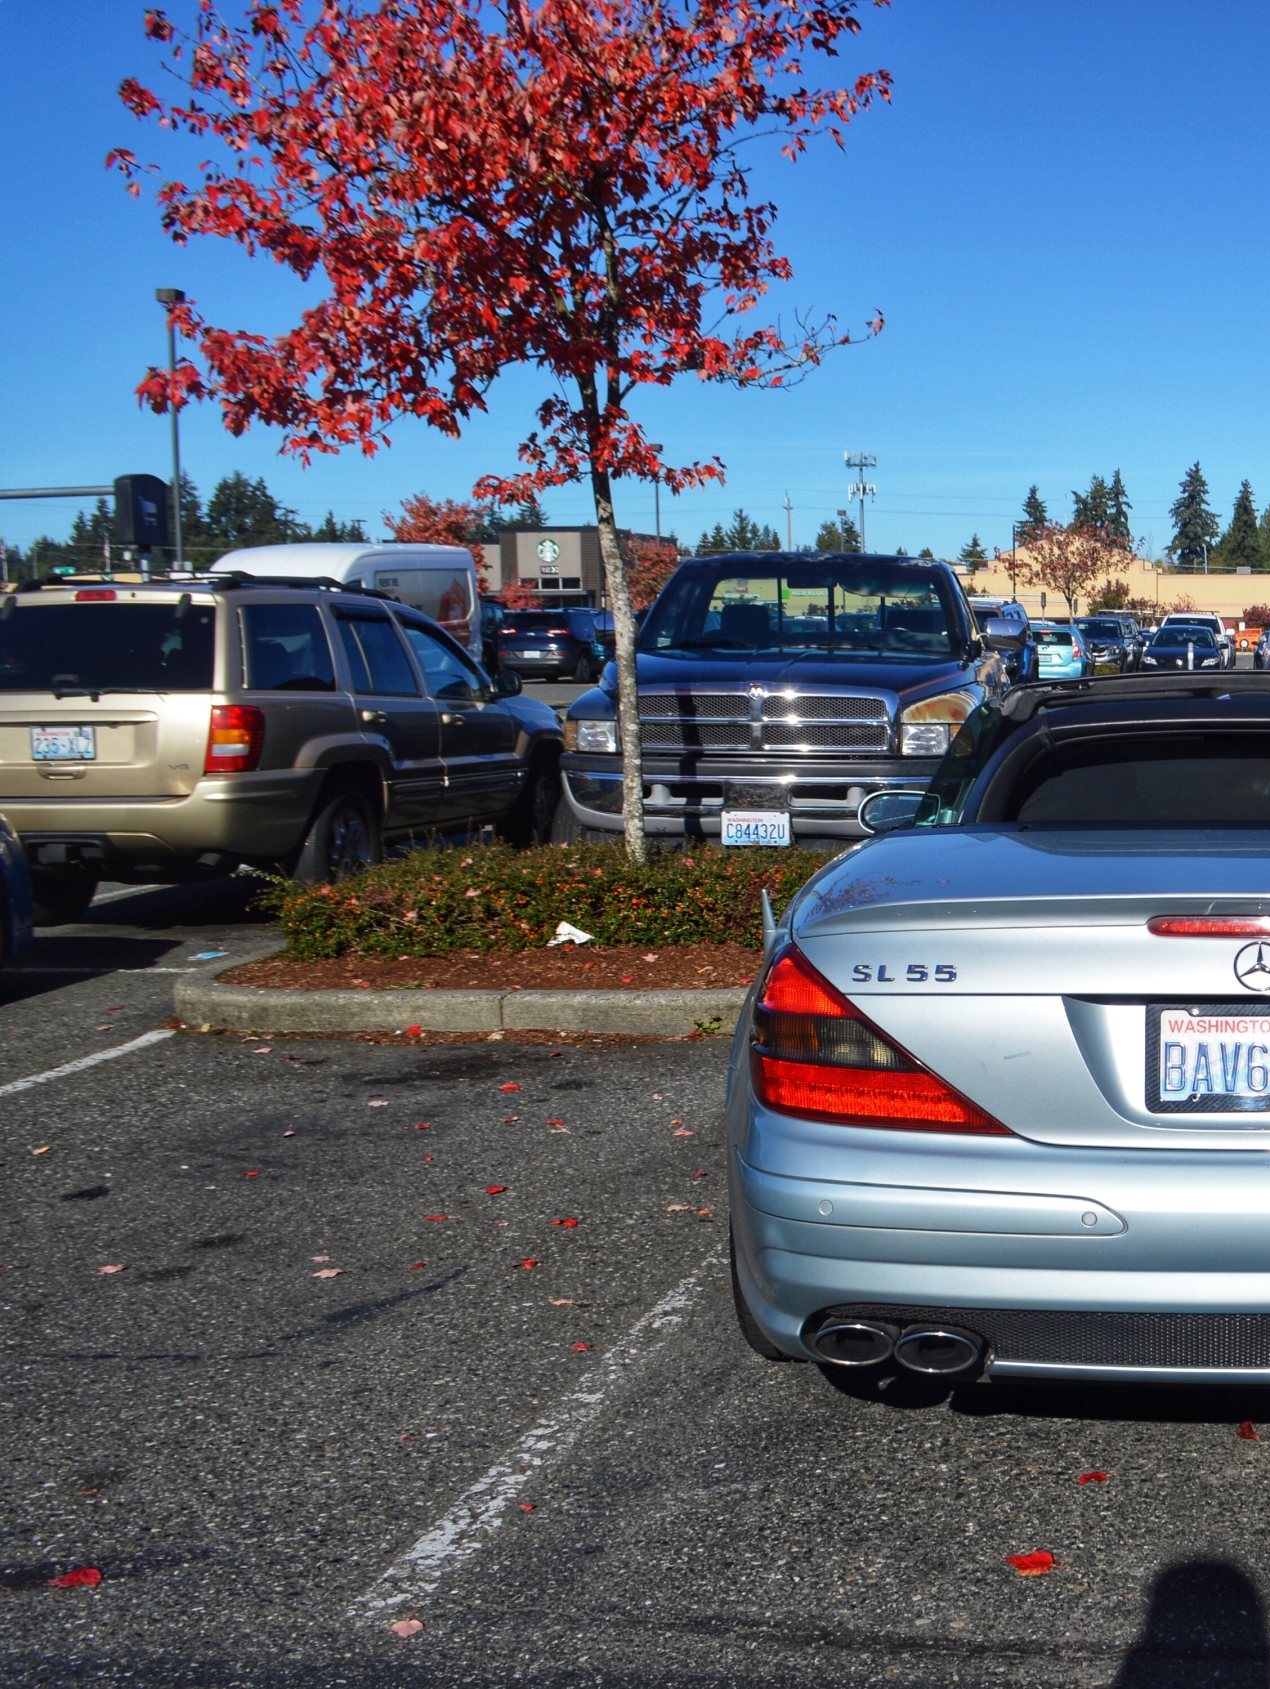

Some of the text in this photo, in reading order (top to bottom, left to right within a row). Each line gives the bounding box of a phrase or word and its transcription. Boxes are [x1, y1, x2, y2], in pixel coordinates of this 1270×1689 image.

[726, 823, 785, 839] C84432U
[851, 964, 957, 982] SL 55
